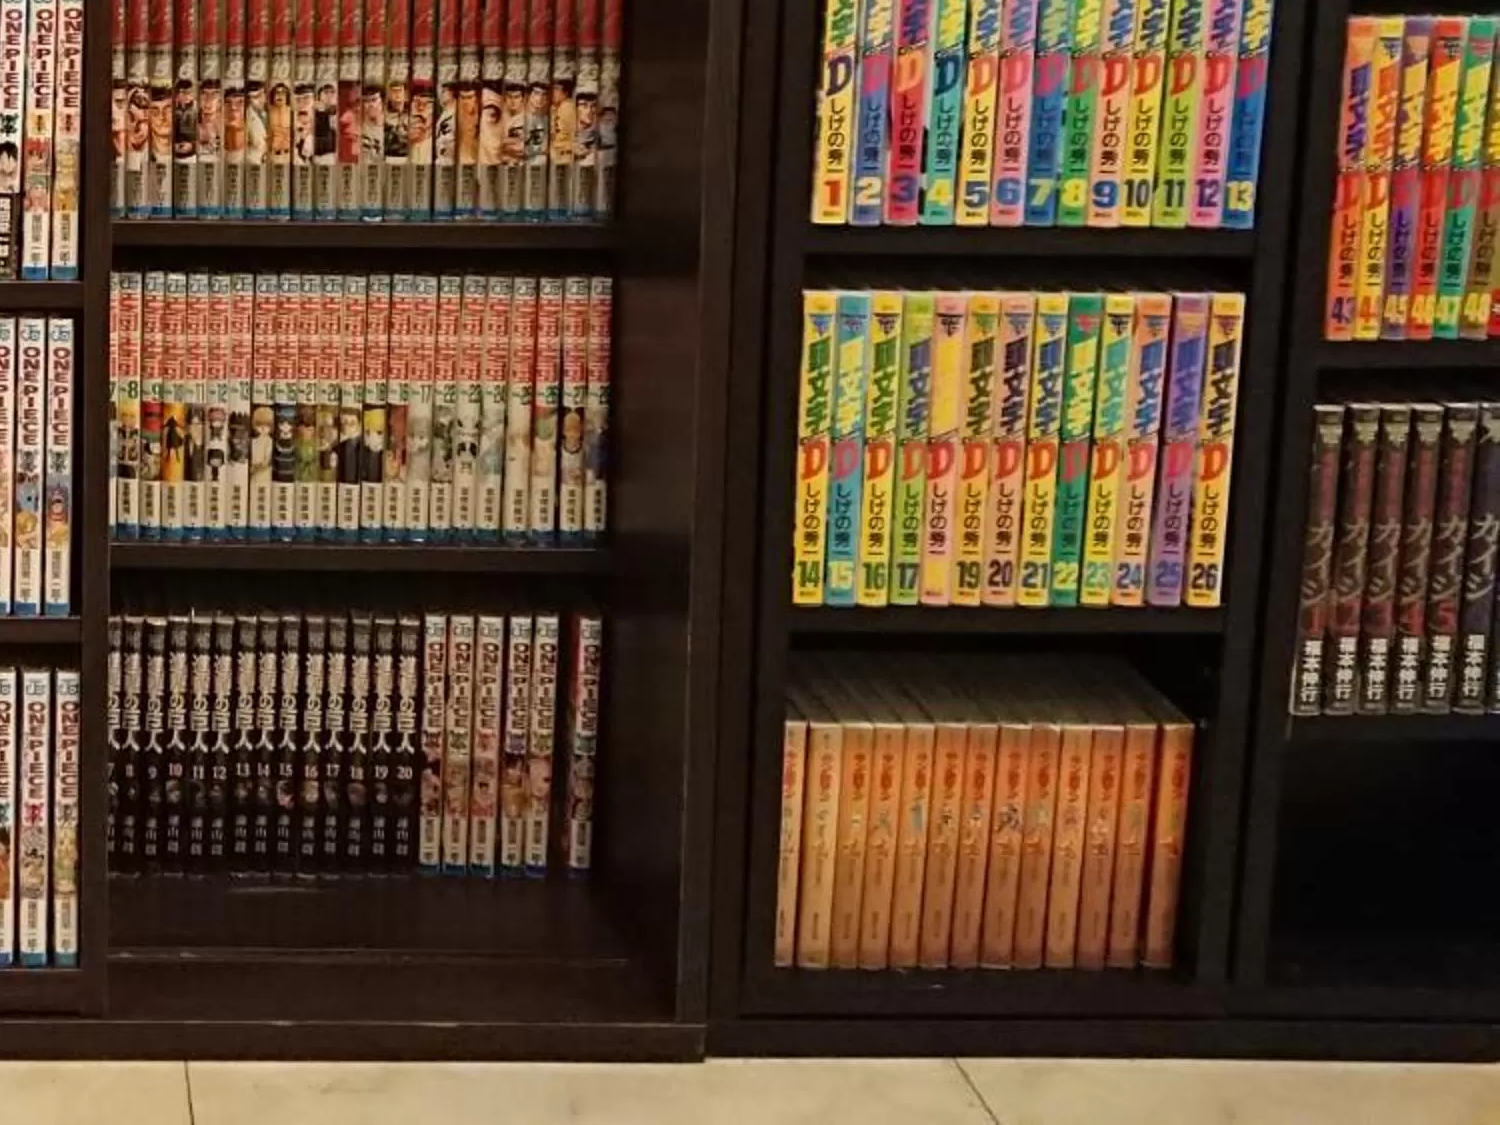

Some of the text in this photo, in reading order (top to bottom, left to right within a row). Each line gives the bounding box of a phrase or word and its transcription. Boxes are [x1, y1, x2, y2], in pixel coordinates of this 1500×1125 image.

[822, 179, 841, 207] 1
[855, 177, 882, 205] 2
[892, 177, 916, 207] 3
[926, 178, 950, 205] 4
[963, 179, 989, 207] 5
[995, 179, 1021, 206] 6
[1029, 178, 1056, 206] 7
[1060, 178, 1087, 207] 8
[1091, 179, 1118, 208] 9
[1123, 179, 1149, 207] 10
[1162, 179, 1185, 207] 11
[1195, 179, 1221, 207] 12
[1226, 180, 1253, 211] 13
[797, 561, 821, 588] 14
[861, 562, 886, 590] 16
[896, 563, 920, 589] 17
[956, 561, 981, 589] 19
[988, 559, 1014, 588] 20
[1022, 561, 1049, 589] 21
[1116, 562, 1142, 589] 24
[1191, 562, 1219, 590] 26
